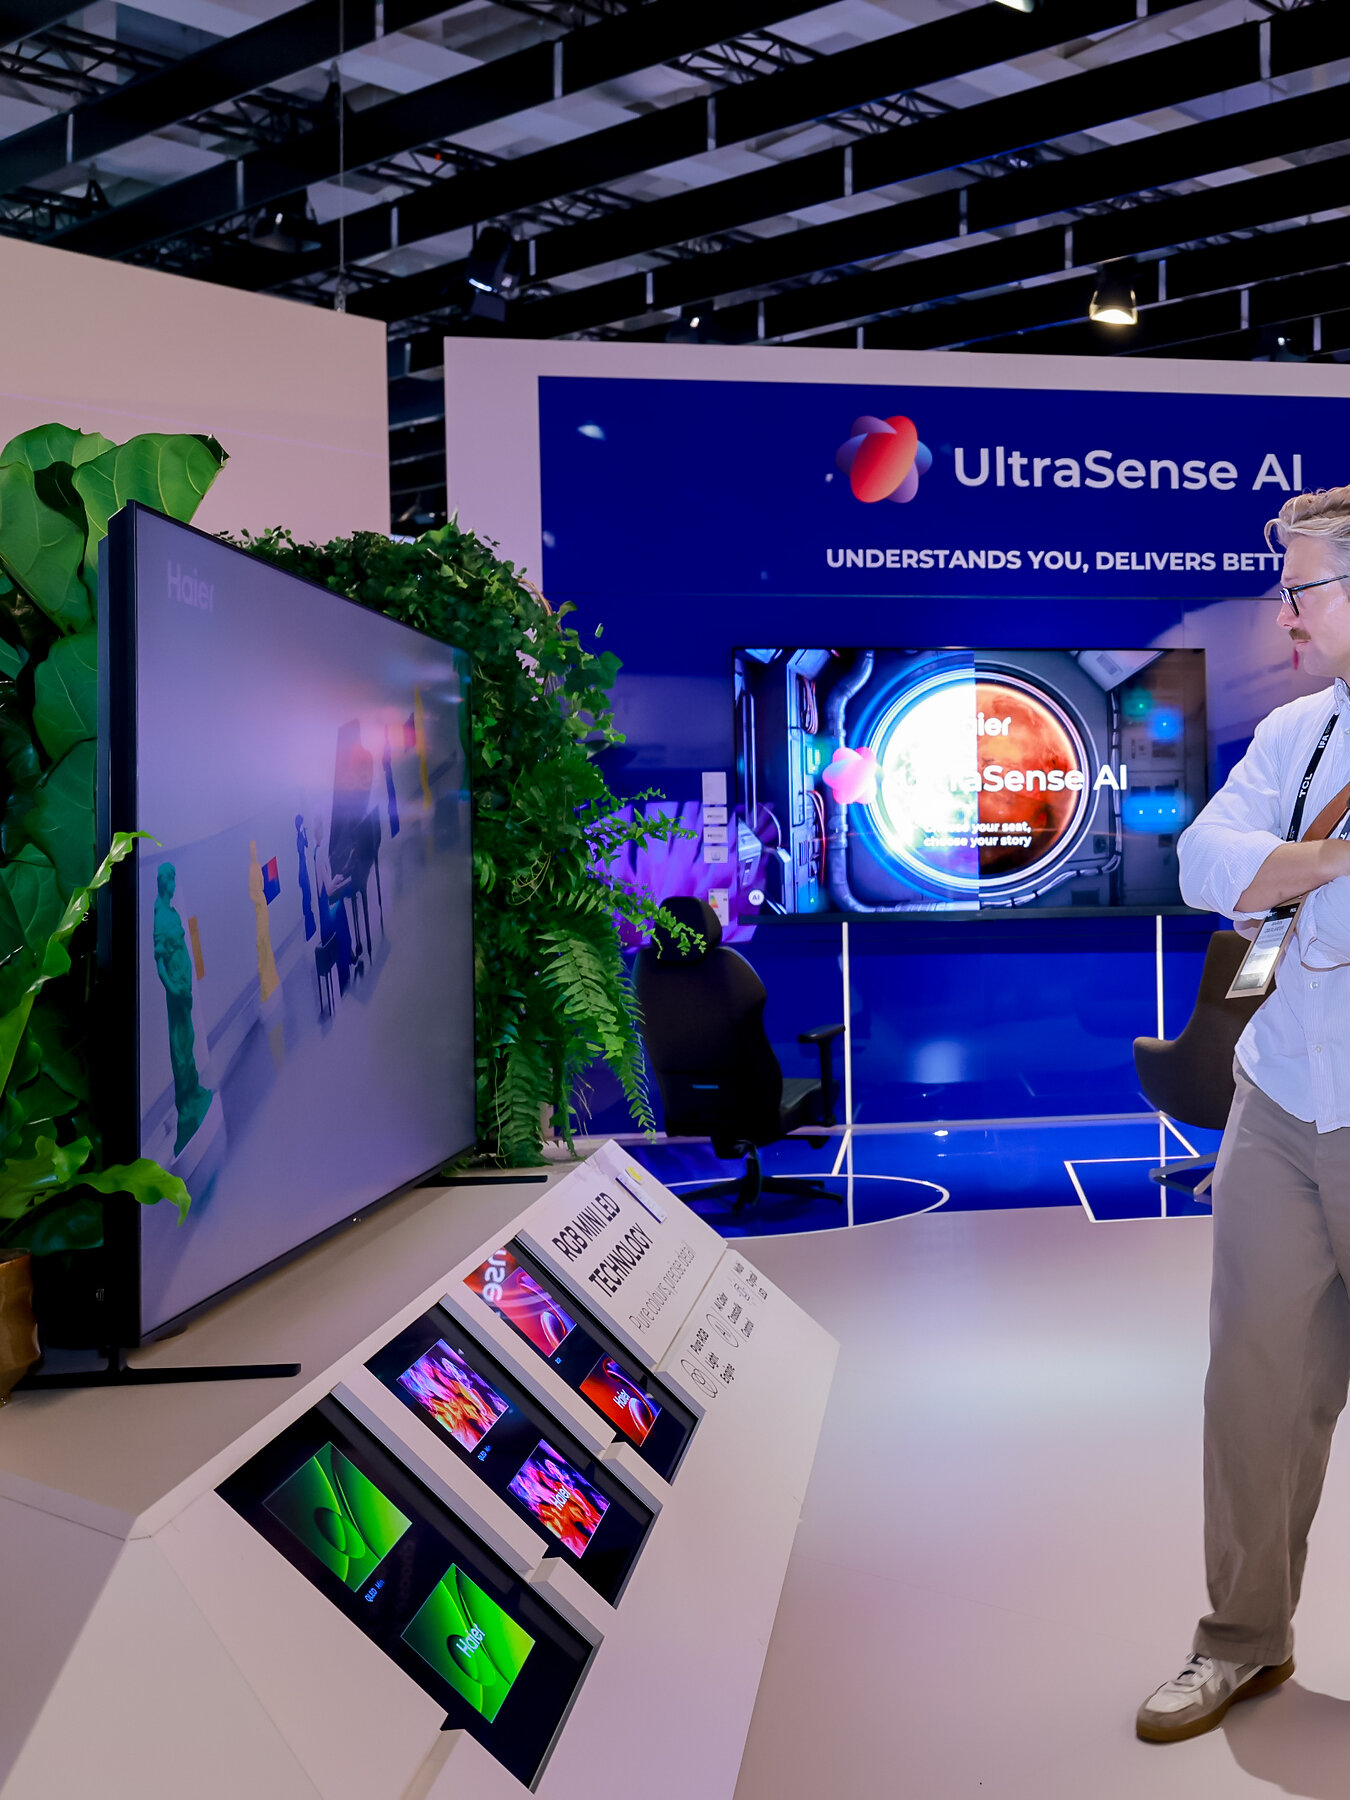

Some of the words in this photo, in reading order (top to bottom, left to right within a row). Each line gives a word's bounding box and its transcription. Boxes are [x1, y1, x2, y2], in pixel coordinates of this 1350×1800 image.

[954, 446, 1239, 491] UltraSense
[1252, 454, 1303, 492] AI
[826, 549, 1021, 570] UNDERSTANDS
[1027, 551, 1089, 574] YOU,
[1096, 551, 1217, 572] DELIVERS
[1223, 552, 1284, 572] BETT
[167, 559, 215, 613] Haier
[976, 711, 1012, 737] ier
[1318, 734, 1329, 749] IFA
[1093, 764, 1128, 791] AI
[1298, 772, 1313, 799] TCL
[971, 823, 1000, 835] your
[1001, 821, 1032, 834] seat,
[970, 837, 999, 849] your
[1000, 835, 1033, 848] story
[552, 1225, 588, 1263] RGB
[571, 1205, 608, 1243] MINI
[591, 1191, 621, 1223] LED
[588, 1222, 653, 1298] TECHNOLOGY
[628, 1306, 650, 1334] Pure
[663, 1260, 686, 1295] precise
[690, 1339, 704, 1355] Pure
[696, 1327, 709, 1342] RGB
[704, 1351, 719, 1370] Light
[719, 1363, 735, 1385] Engine
[612, 1388, 631, 1410] Haier
[550, 1483, 571, 1511] Haier
[364, 1587, 378, 1603] QLED
[455, 1622, 486, 1659] Haier
